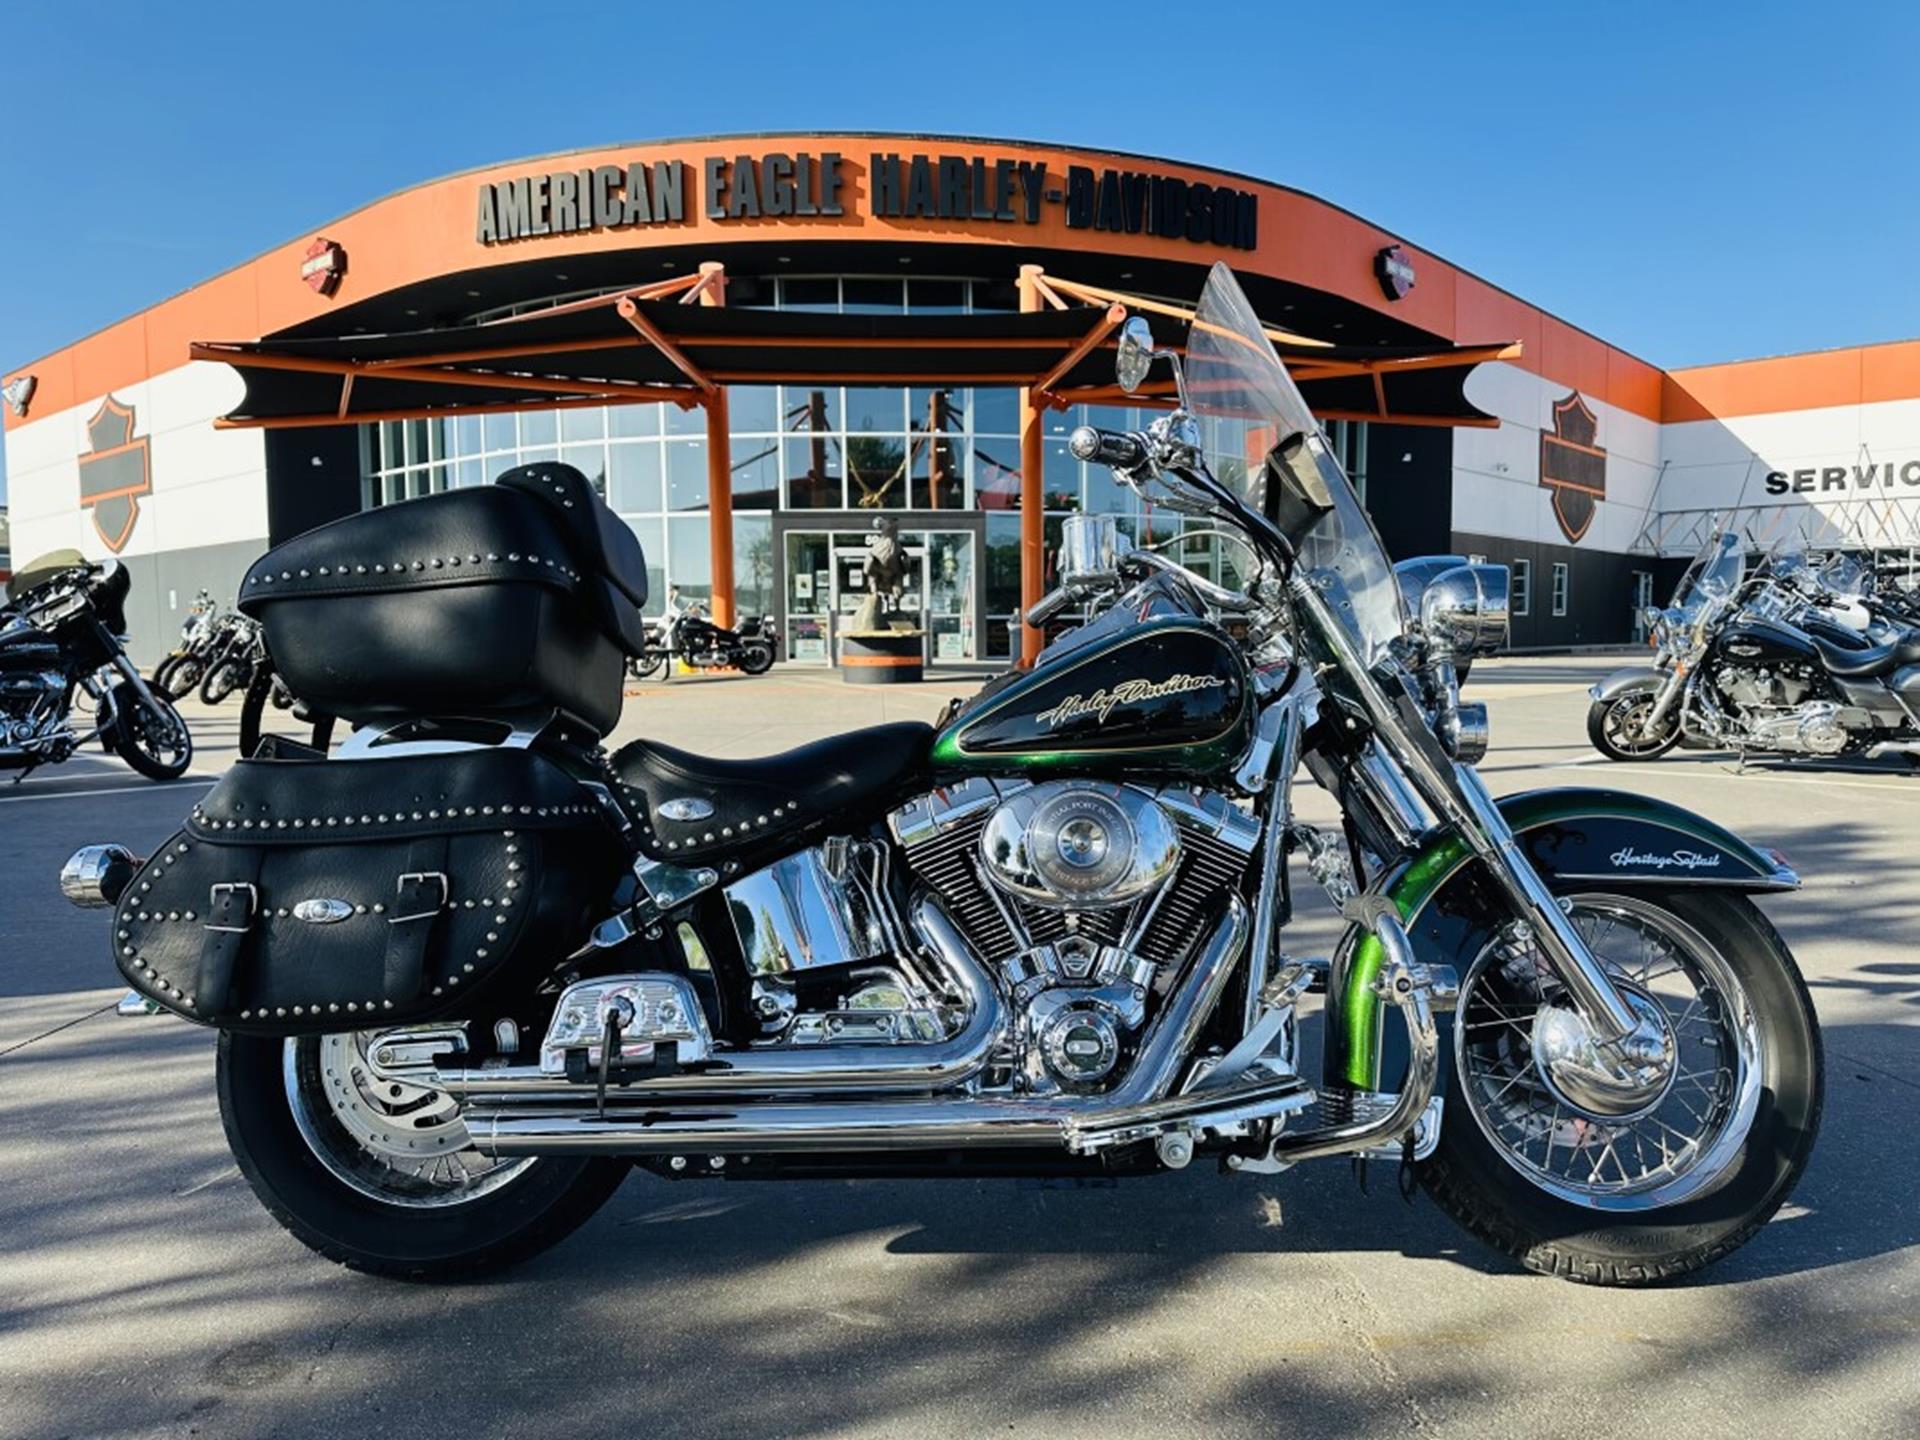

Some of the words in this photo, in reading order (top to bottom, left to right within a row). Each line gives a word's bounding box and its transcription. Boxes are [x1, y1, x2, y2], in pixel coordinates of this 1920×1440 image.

[476, 159, 684, 244] AMERICAN
[704, 152, 843, 218] EAGLE
[870, 152, 1259, 251] HARLEY-DAVIDSON
[1765, 460, 1920, 496] SERVIC
[1609, 847, 1674, 869] Heritage
[1672, 849, 1720, 869] Softail
